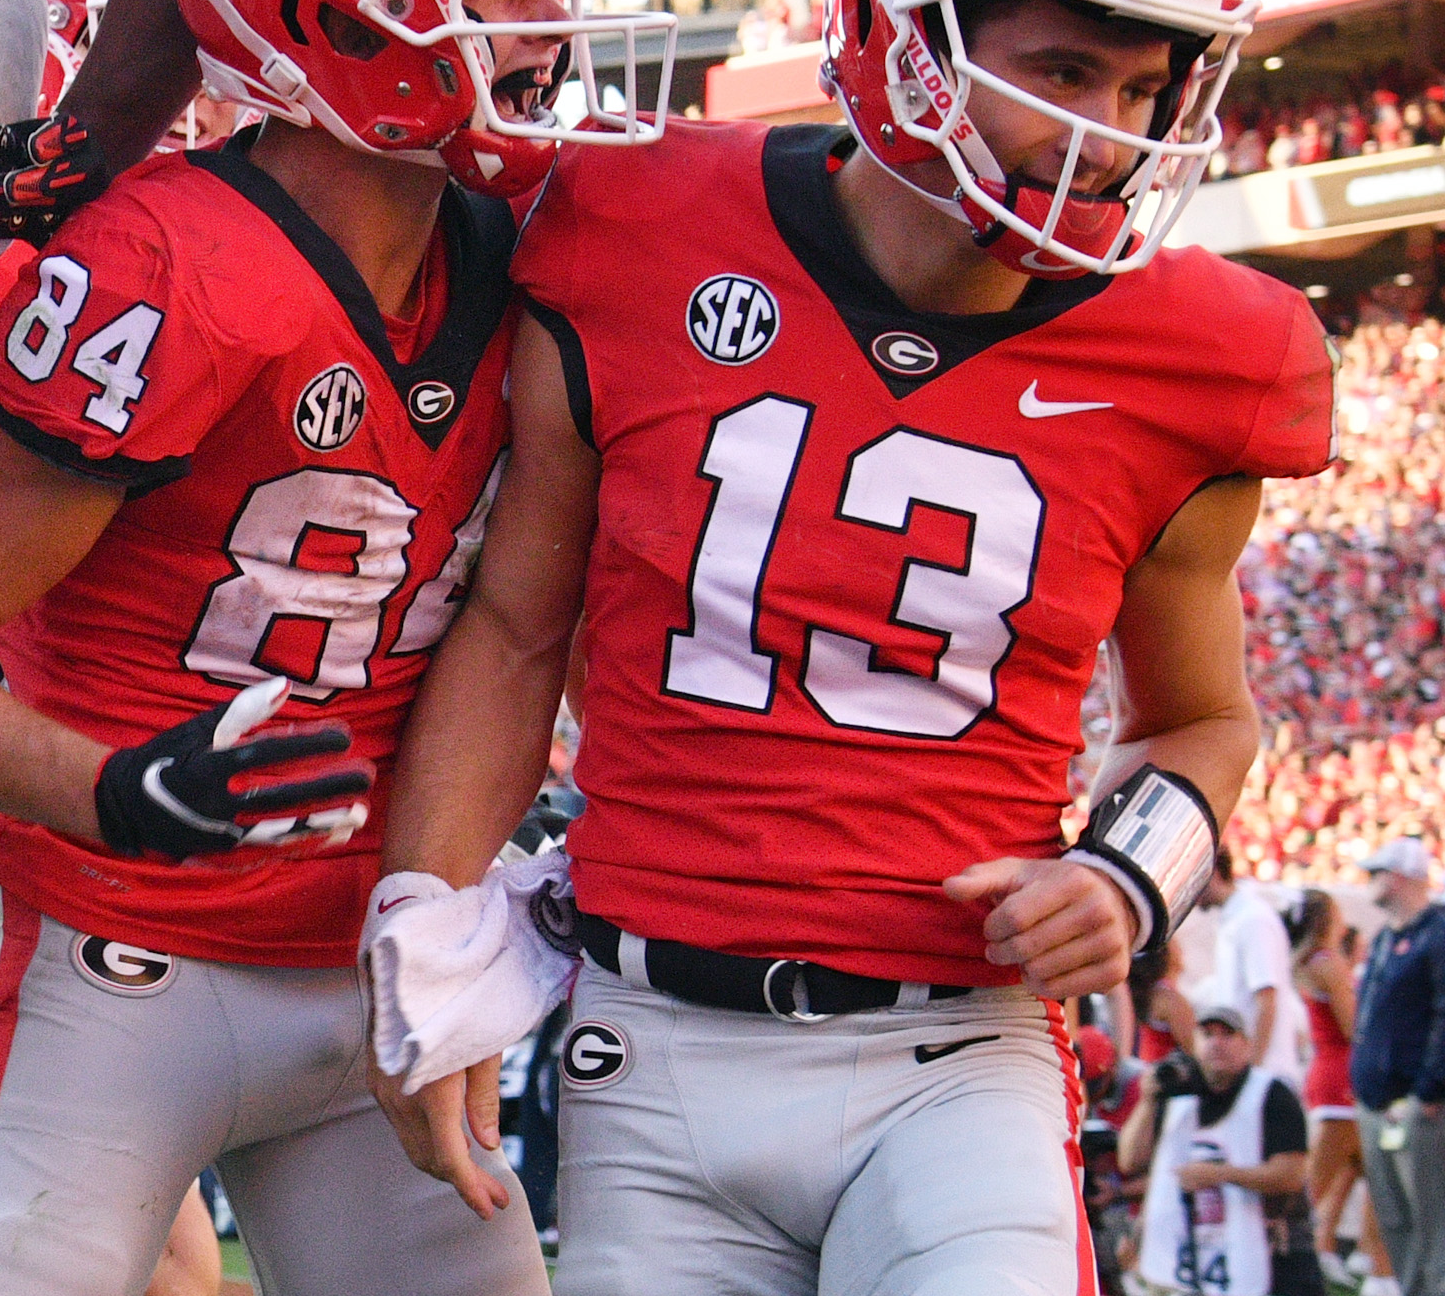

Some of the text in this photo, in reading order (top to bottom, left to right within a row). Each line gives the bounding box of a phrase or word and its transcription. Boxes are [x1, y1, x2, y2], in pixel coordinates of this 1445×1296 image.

[903, 29, 975, 142] ULLDOS
[4, 253, 166, 435] 84
[689, 281, 778, 360] SEC
[298, 369, 365, 447] SEC
[660, 391, 1046, 741] 13
[564, 1024, 625, 1081] G
